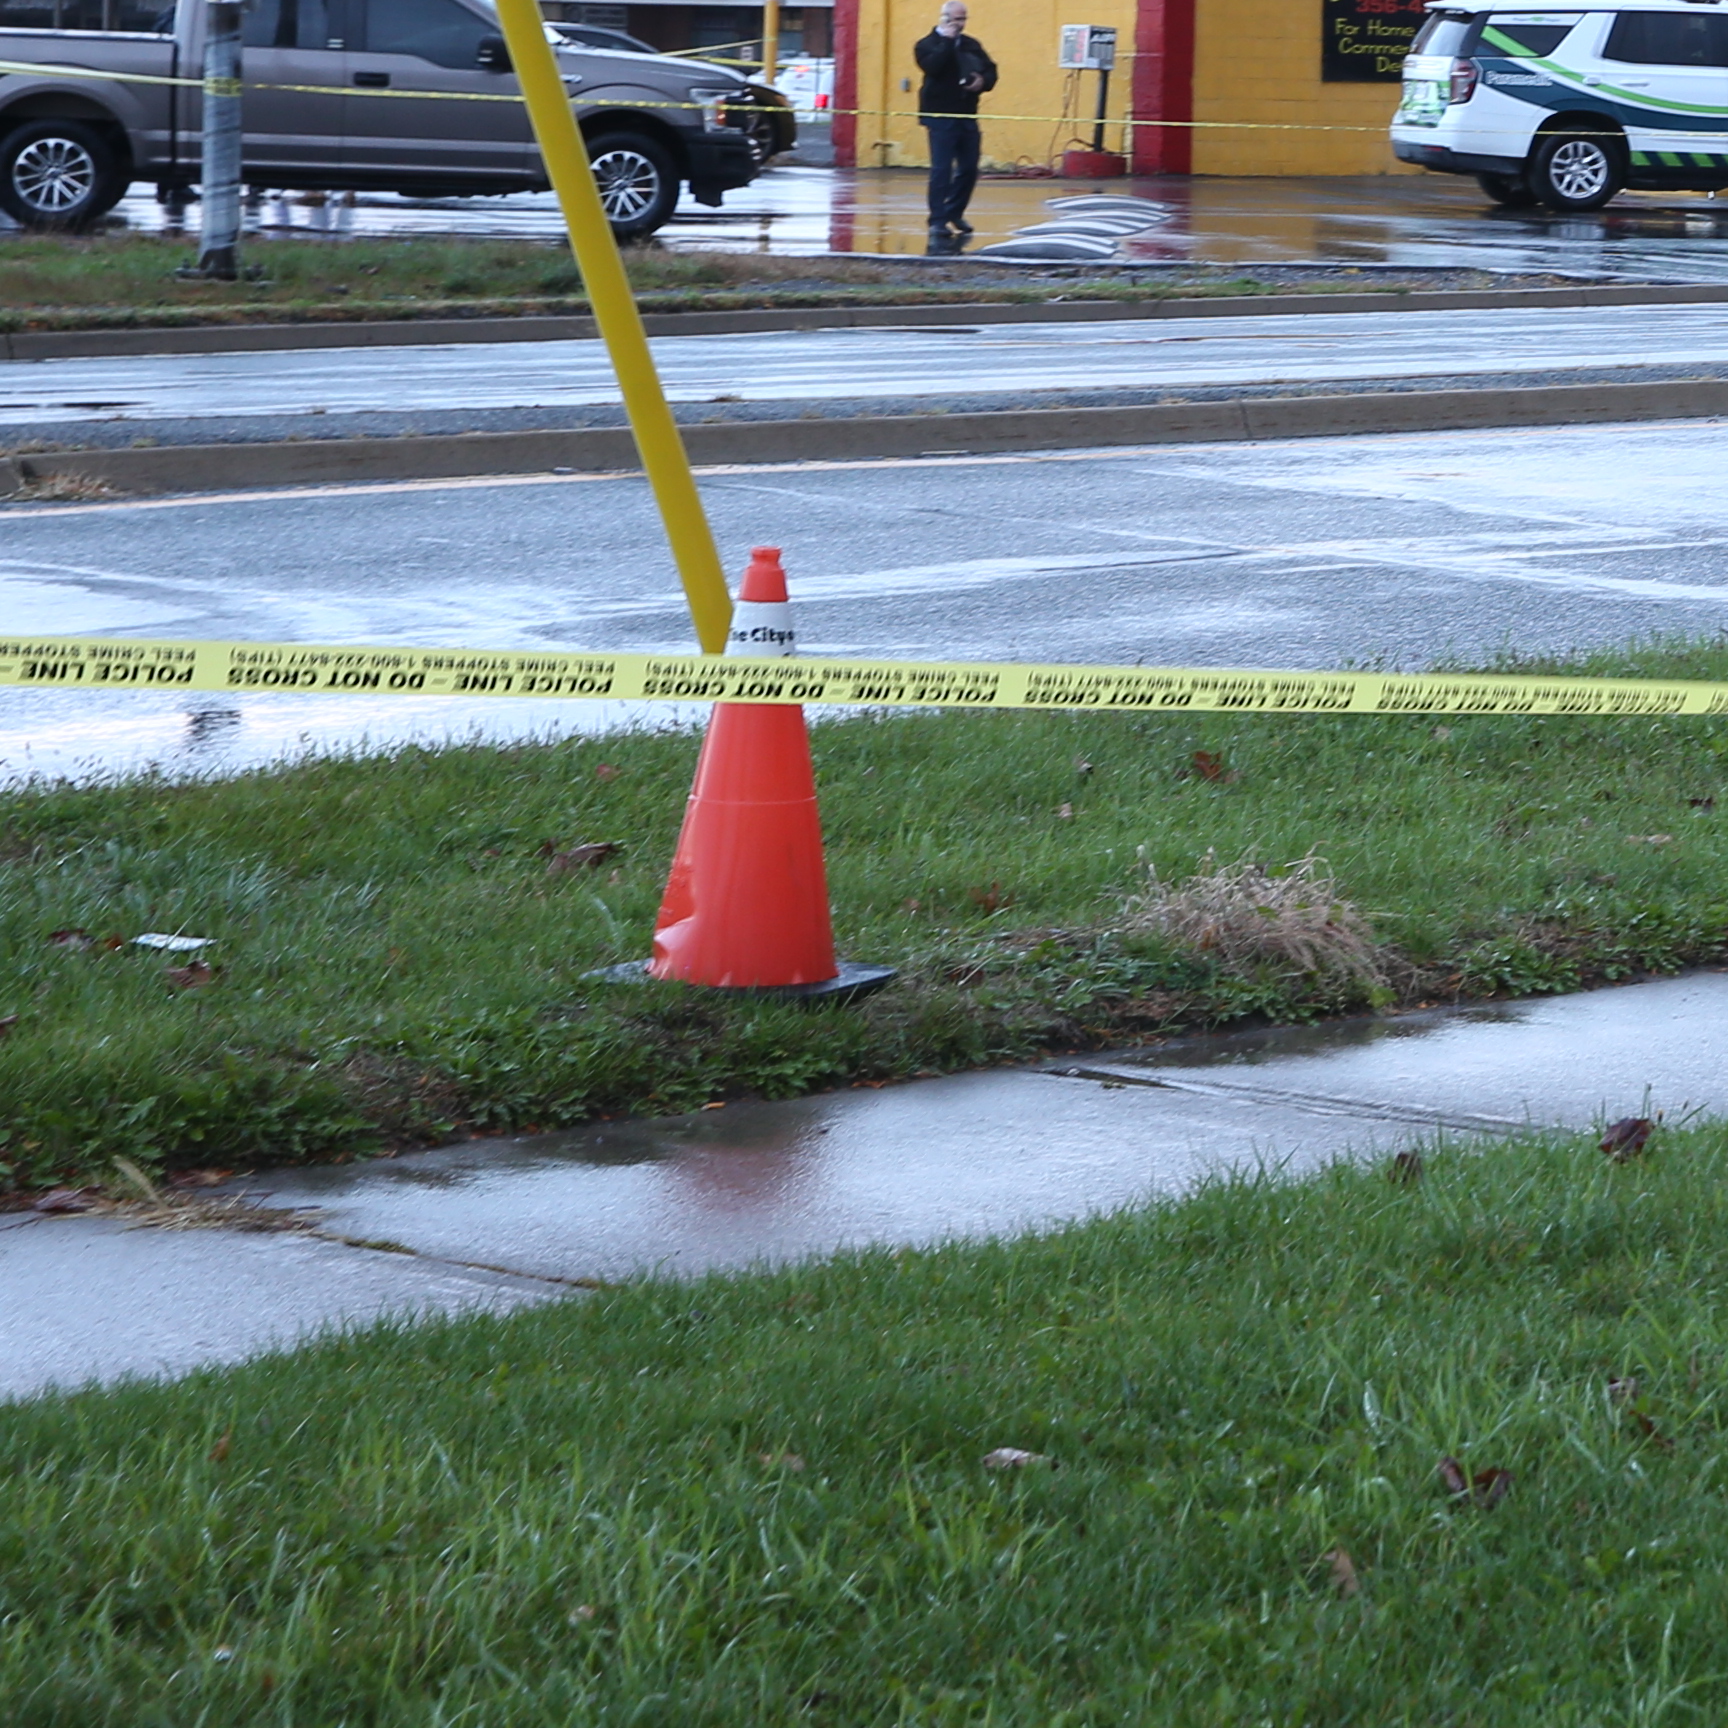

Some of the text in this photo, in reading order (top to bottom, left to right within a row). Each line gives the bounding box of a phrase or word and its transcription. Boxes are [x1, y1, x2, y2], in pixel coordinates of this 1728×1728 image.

[1335, 18, 1416, 37] For Home
[152, 646, 196, 663] PEEL
[422, 653, 509, 672] STOPPERS
[18, 660, 194, 683] POLICE LINE
[516, 656, 569, 674] CRIME
[575, 658, 616, 676] PEEL
[226, 666, 614, 694] POLICE LINE DO NOT CROSS
[642, 677, 998, 704] POLICE LINE DO NOT CROSS
[1022, 689, 1353, 710] POLICE LINE DO NOT CROSS
